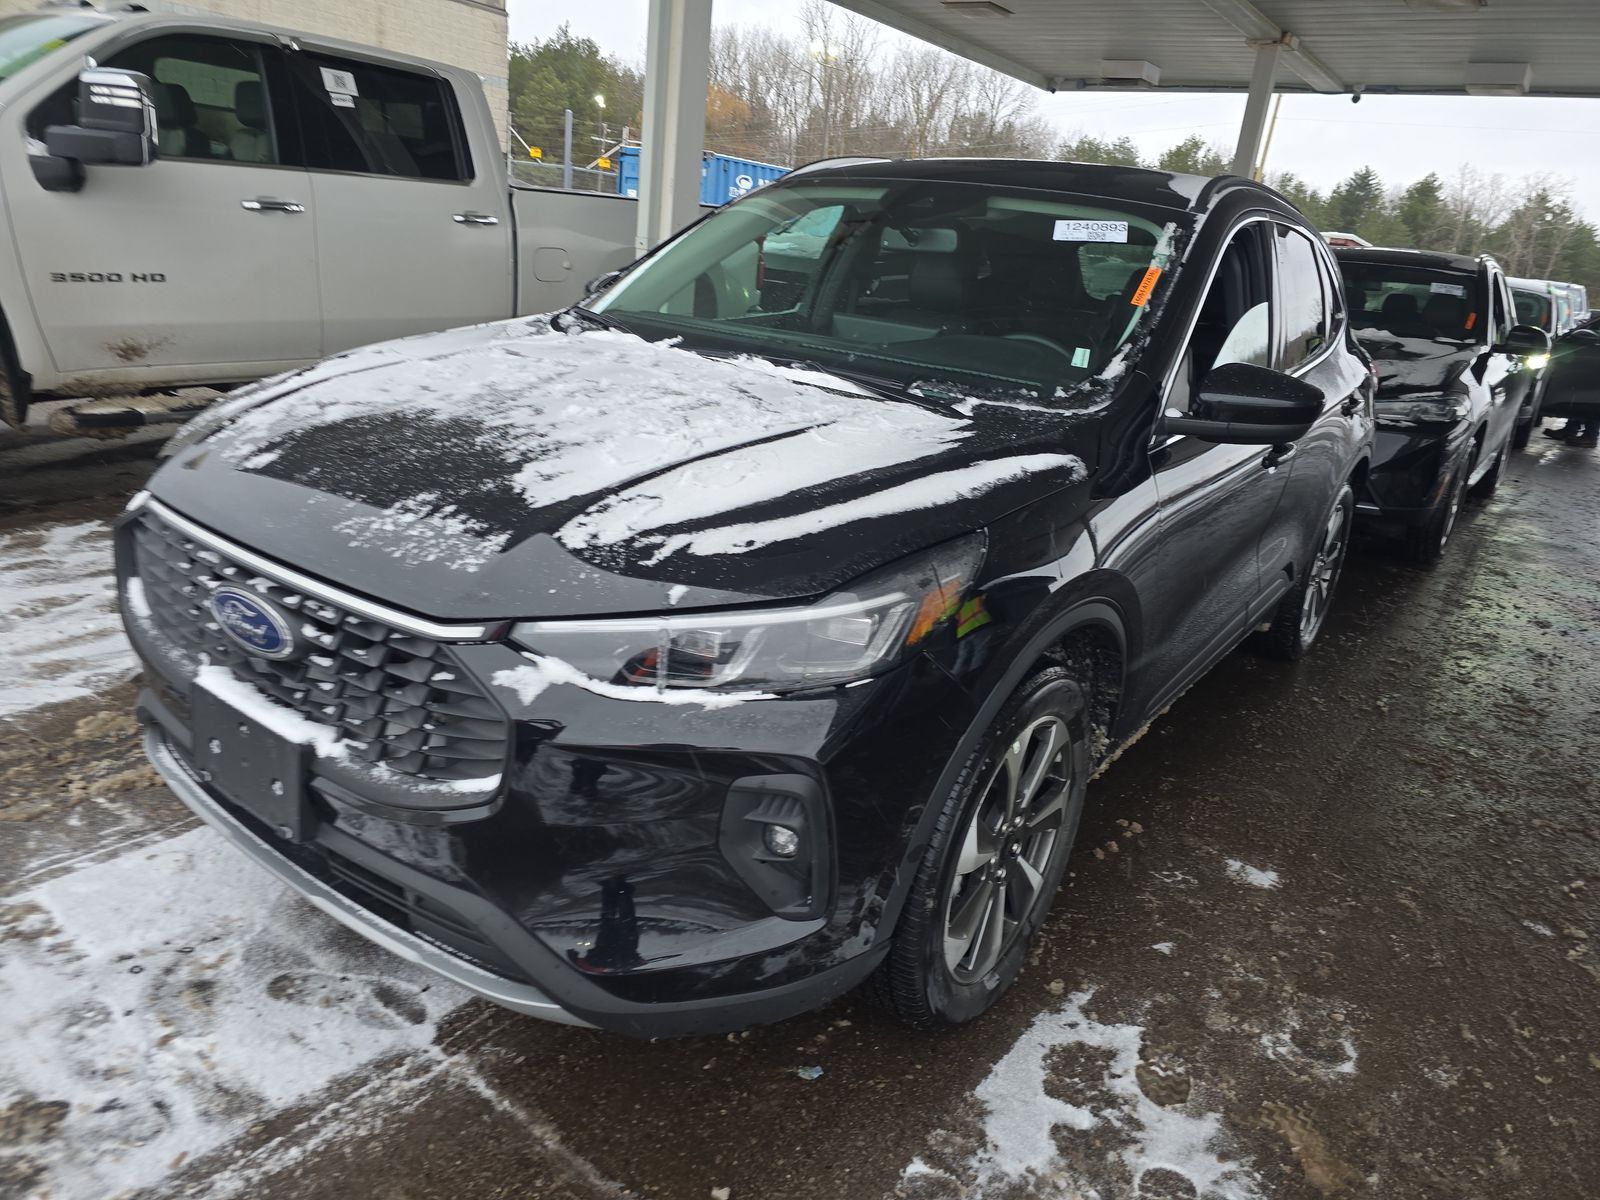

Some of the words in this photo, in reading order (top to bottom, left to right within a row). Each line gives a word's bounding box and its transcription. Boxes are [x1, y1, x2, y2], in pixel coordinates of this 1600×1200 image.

[1065, 222, 1127, 232] 1240893
[50, 272, 123, 283] 3500
[131, 273, 167, 283] HD
[221, 600, 269, 644] Ford
